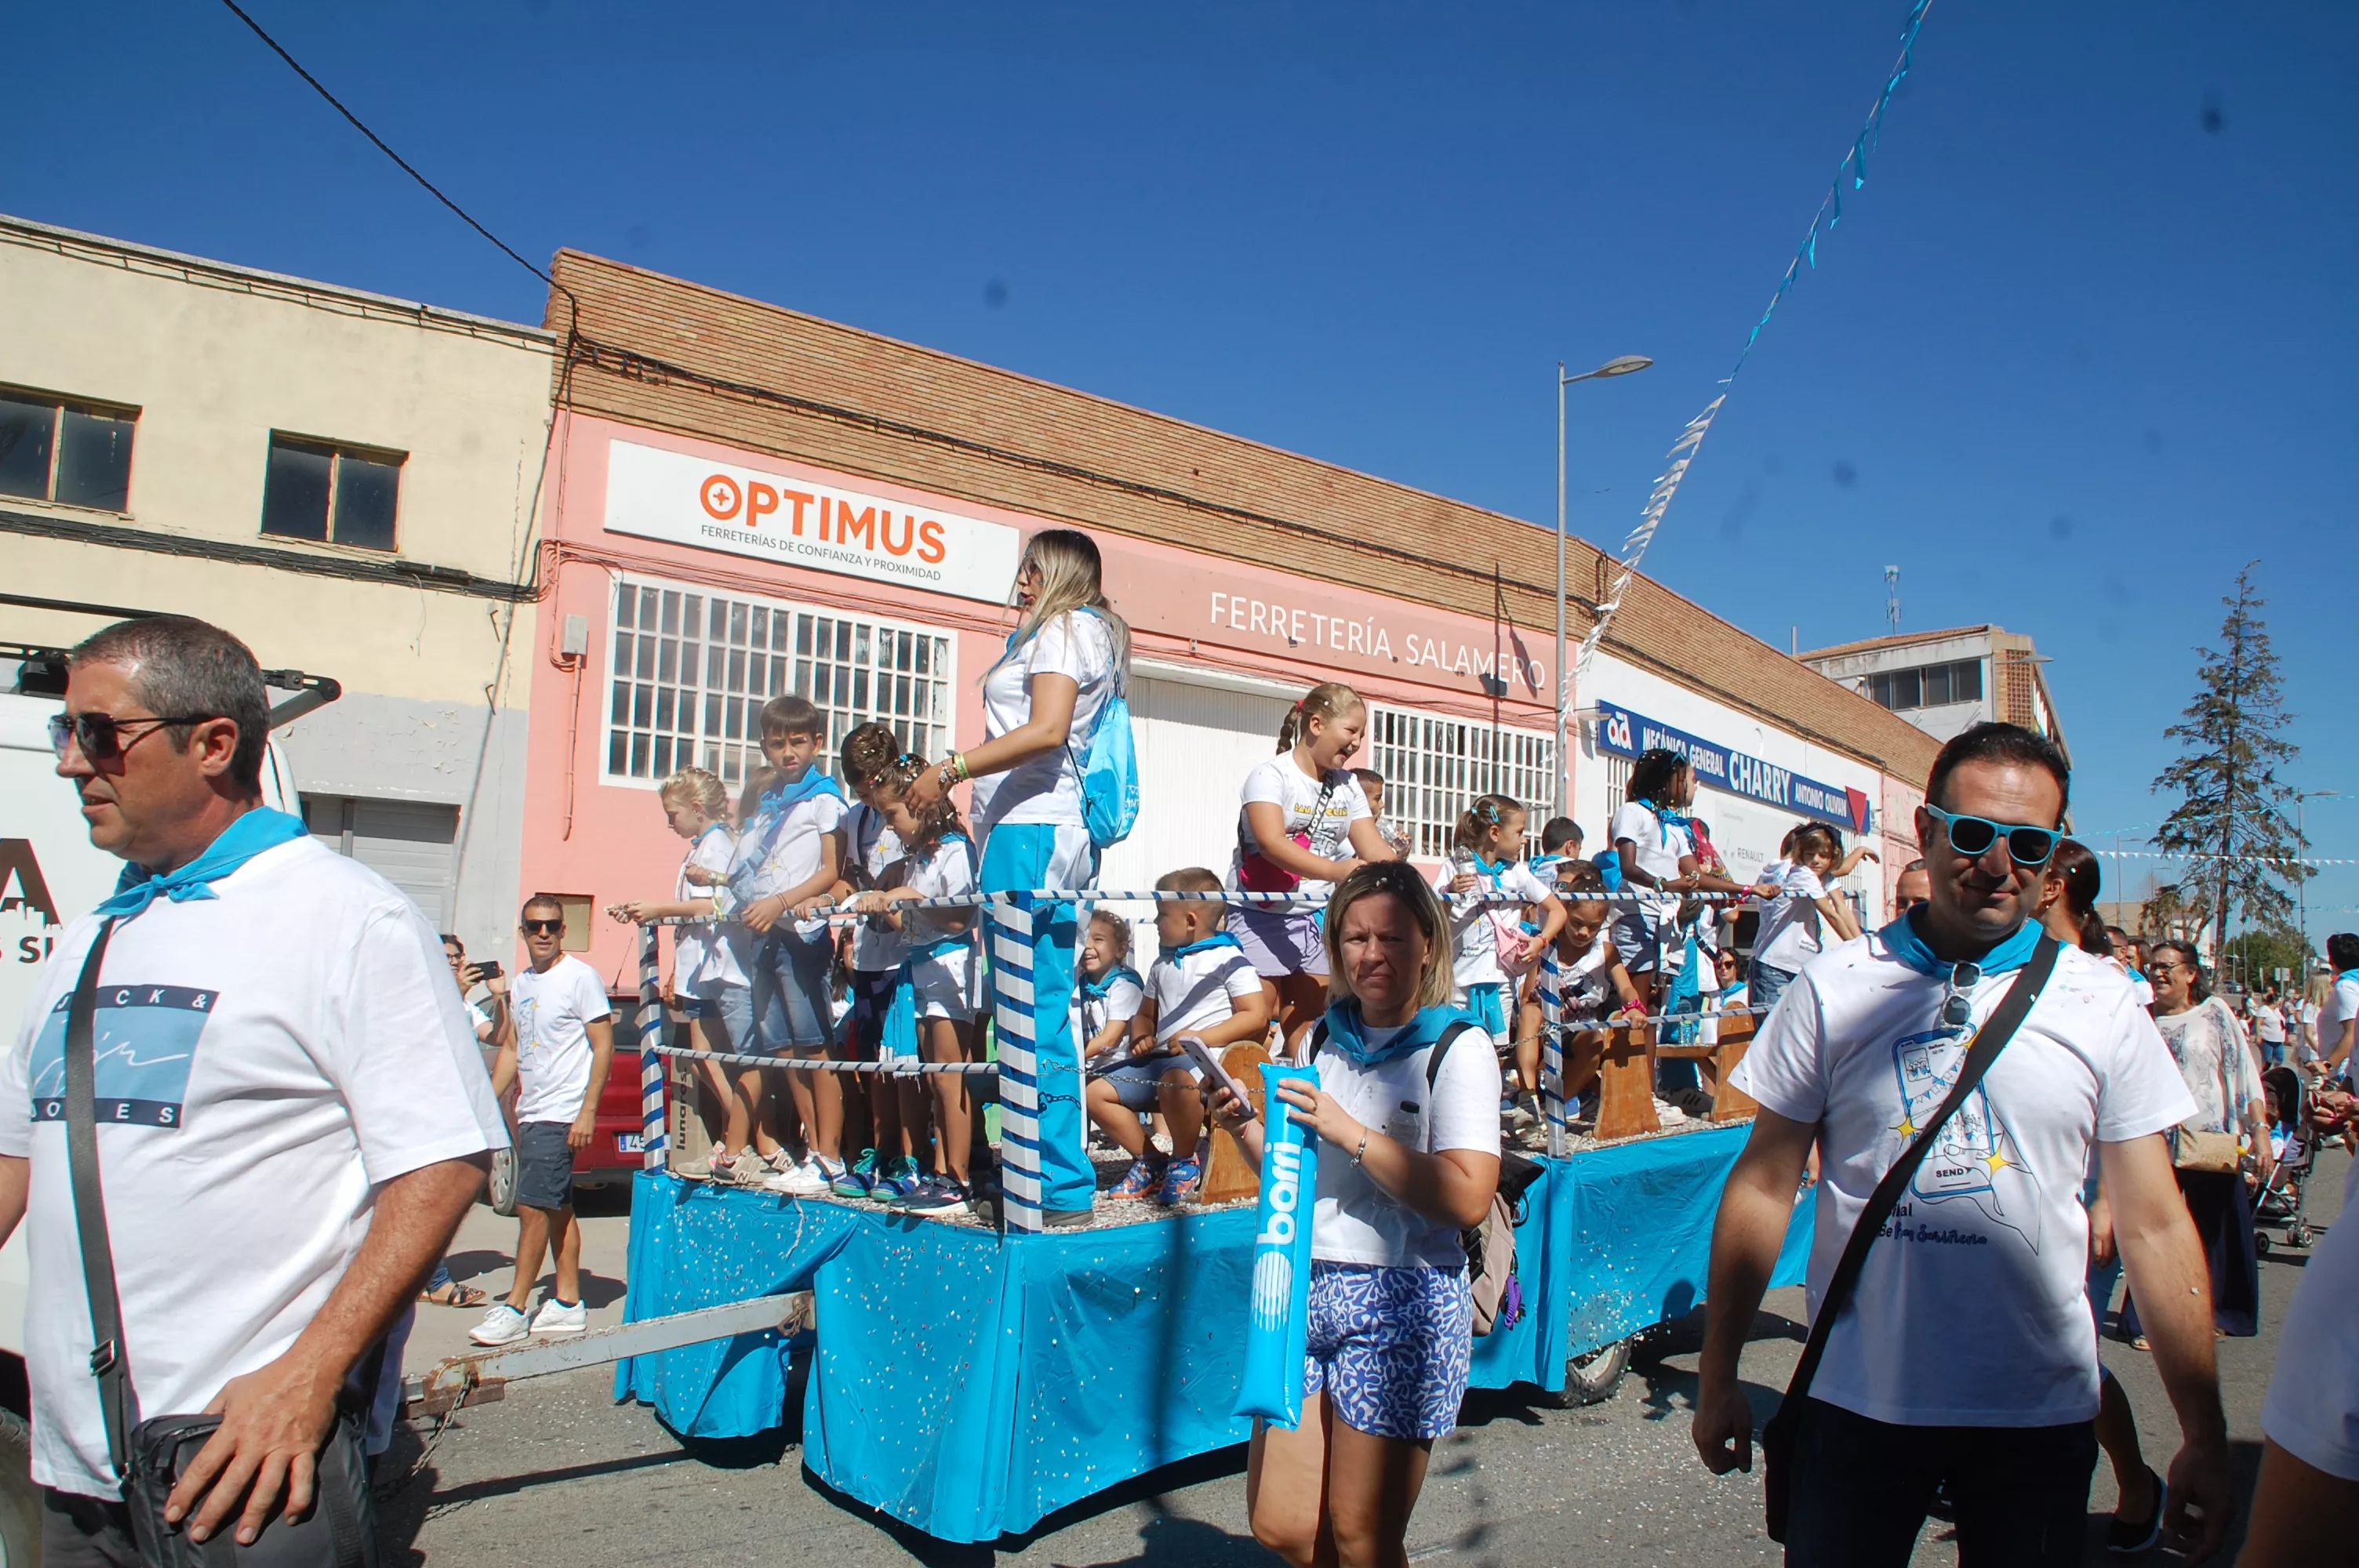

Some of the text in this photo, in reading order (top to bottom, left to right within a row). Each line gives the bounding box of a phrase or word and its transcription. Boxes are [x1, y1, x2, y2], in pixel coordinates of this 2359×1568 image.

[700, 474, 945, 564] OPTIMUS
[701, 524, 941, 581] FERRETERÍAS DE CONFIANZA Y PROXIMIDAD
[1210, 591, 1546, 689] FERRETERÍA SALAMERO
[1689, 744, 1725, 778] GENERAL
[1729, 752, 1792, 806] CHARRY
[1795, 782, 1823, 811] ANTONIO
[1737, 848, 1763, 862] RENAULT
[56, 989, 207, 1010] JCK &
[30, 1103, 174, 1123] JOES
[1256, 1142, 1301, 1245] barri
[1936, 1168, 1964, 1178] SEND
